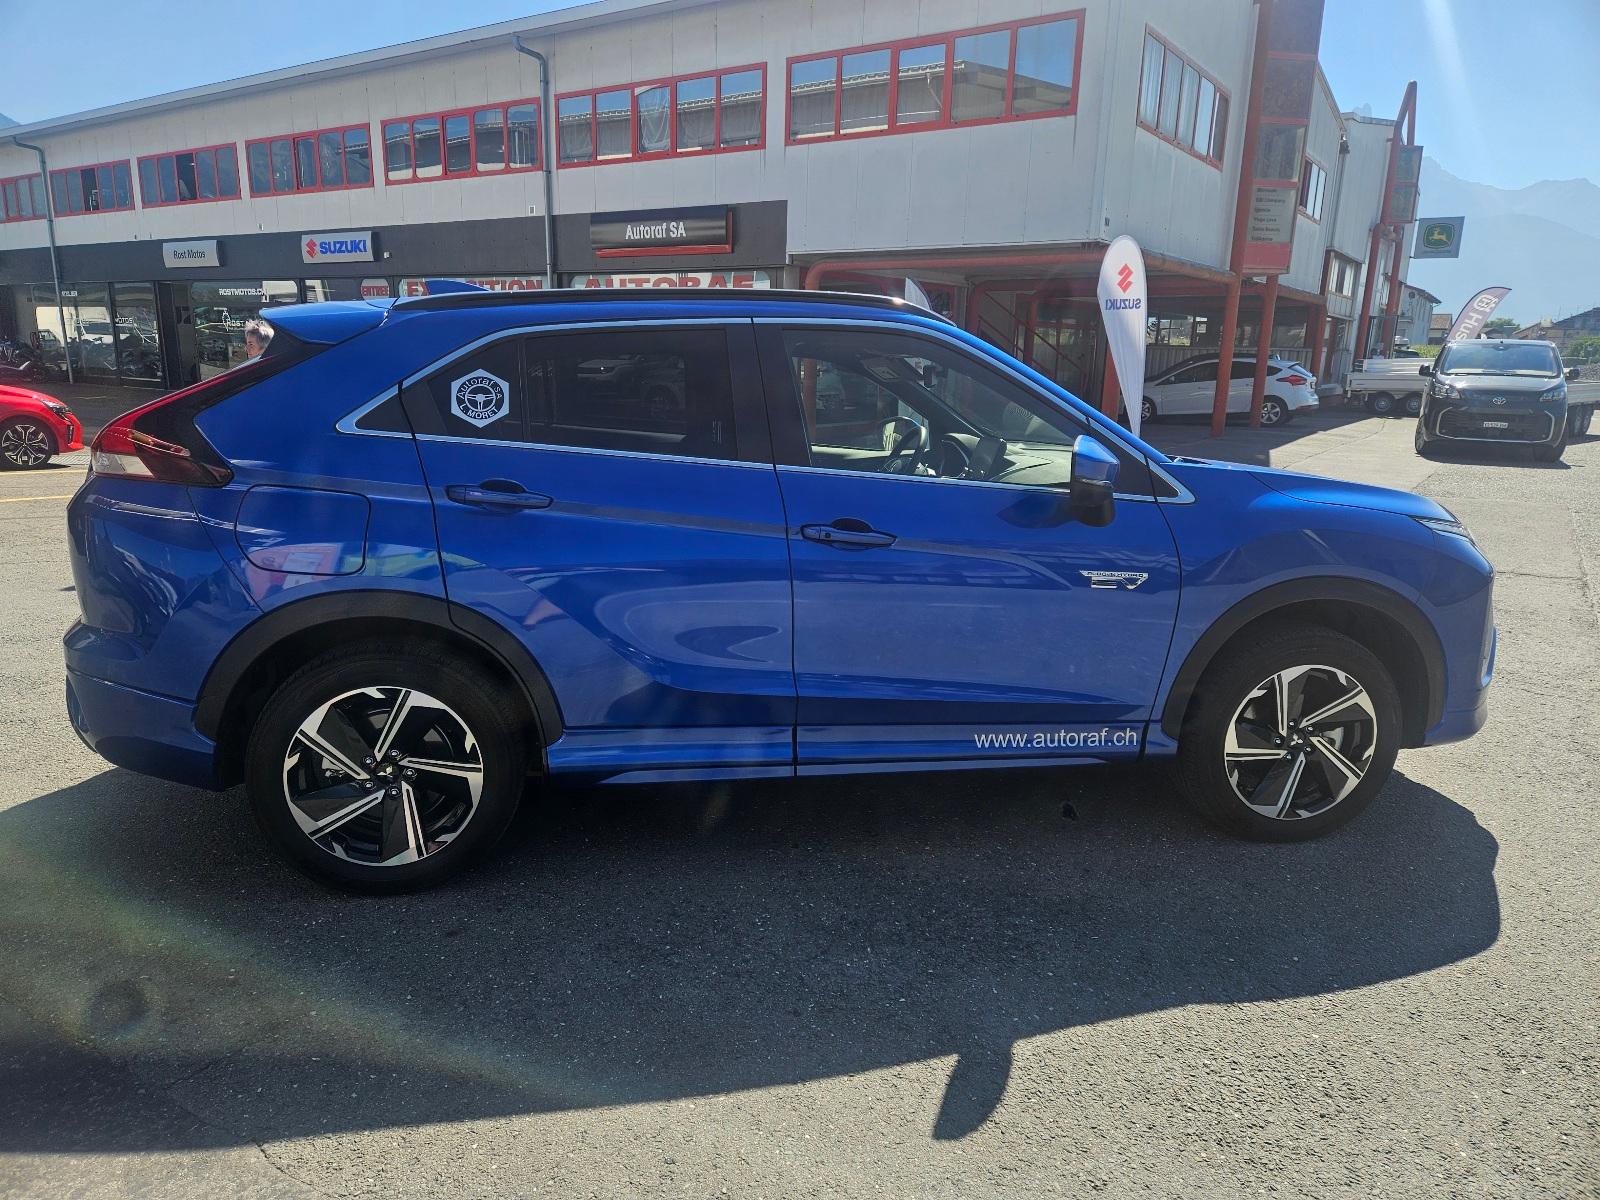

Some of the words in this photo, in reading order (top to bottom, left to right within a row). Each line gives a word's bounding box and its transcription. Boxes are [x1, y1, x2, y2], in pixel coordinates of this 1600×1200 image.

[625, 222, 667, 240] Autoraf
[669, 221, 686, 238] SA
[173, 250, 187, 260] Rost
[187, 249, 206, 259] Motos
[319, 239, 368, 255] SUZUKI
[457, 378, 495, 400] Autoraf
[494, 386, 503, 400] SA
[467, 406, 499, 419] MORET
[974, 728, 1137, 748] www.autoraf.ch
